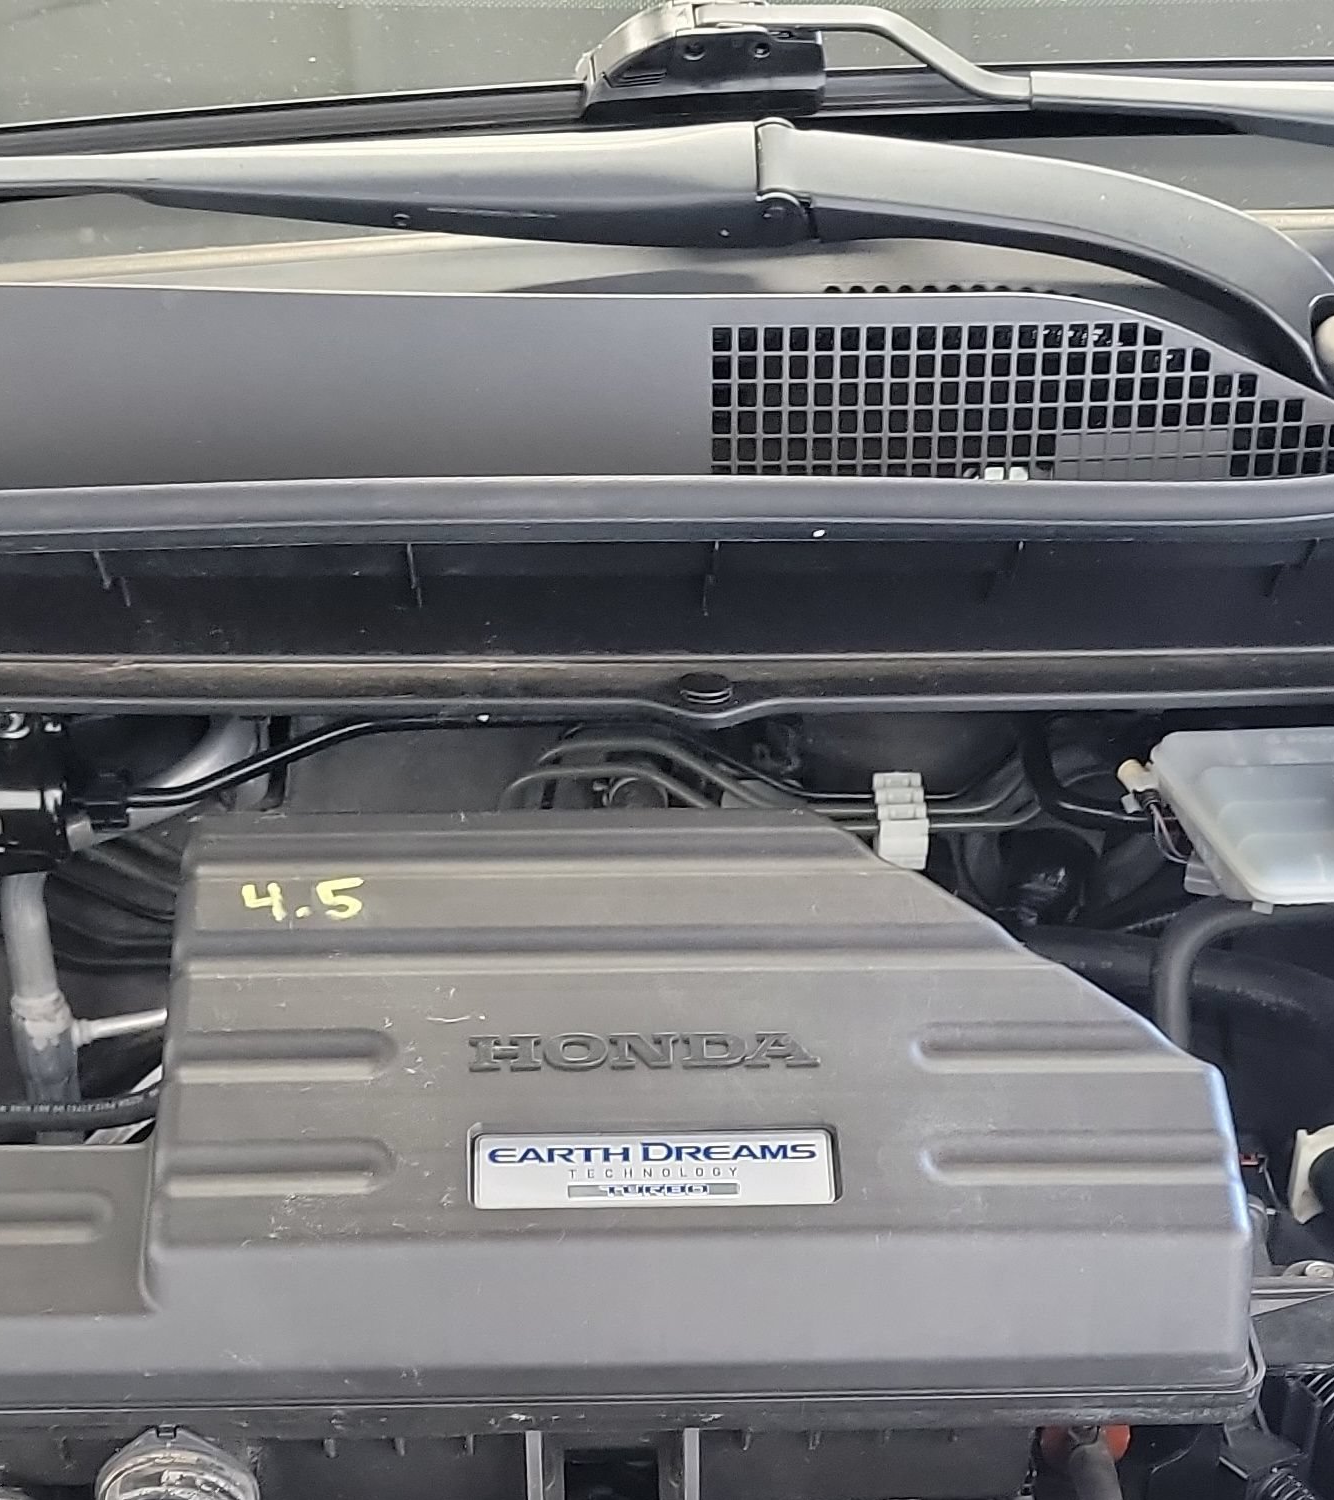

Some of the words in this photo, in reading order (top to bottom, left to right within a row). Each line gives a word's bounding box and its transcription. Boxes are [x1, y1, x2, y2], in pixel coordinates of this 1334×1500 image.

[242, 877, 364, 921] 4.5
[469, 1032, 820, 1072] HONDA
[489, 1147, 630, 1163] EARTH
[641, 1142, 816, 1161] DREAMS
[568, 1167, 738, 1178] TECHNOLOGY
[599, 1184, 709, 1196] TURBO
